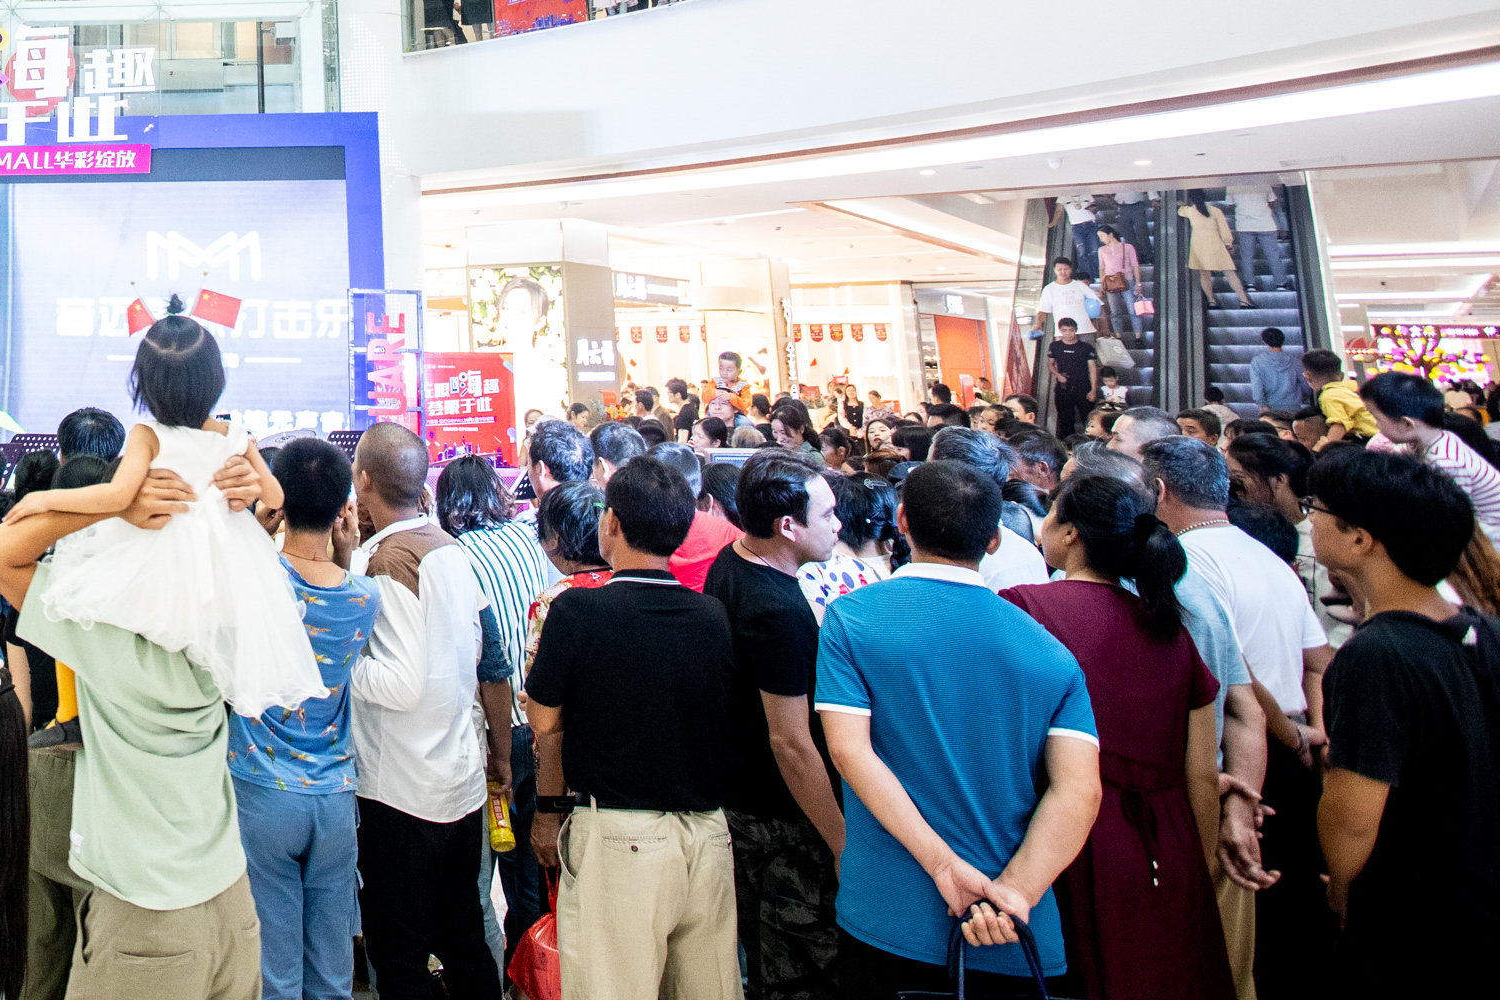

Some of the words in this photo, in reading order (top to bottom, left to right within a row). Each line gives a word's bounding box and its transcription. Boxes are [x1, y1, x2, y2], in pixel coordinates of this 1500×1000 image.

[56, 296, 348, 339] 音迈打击乐
